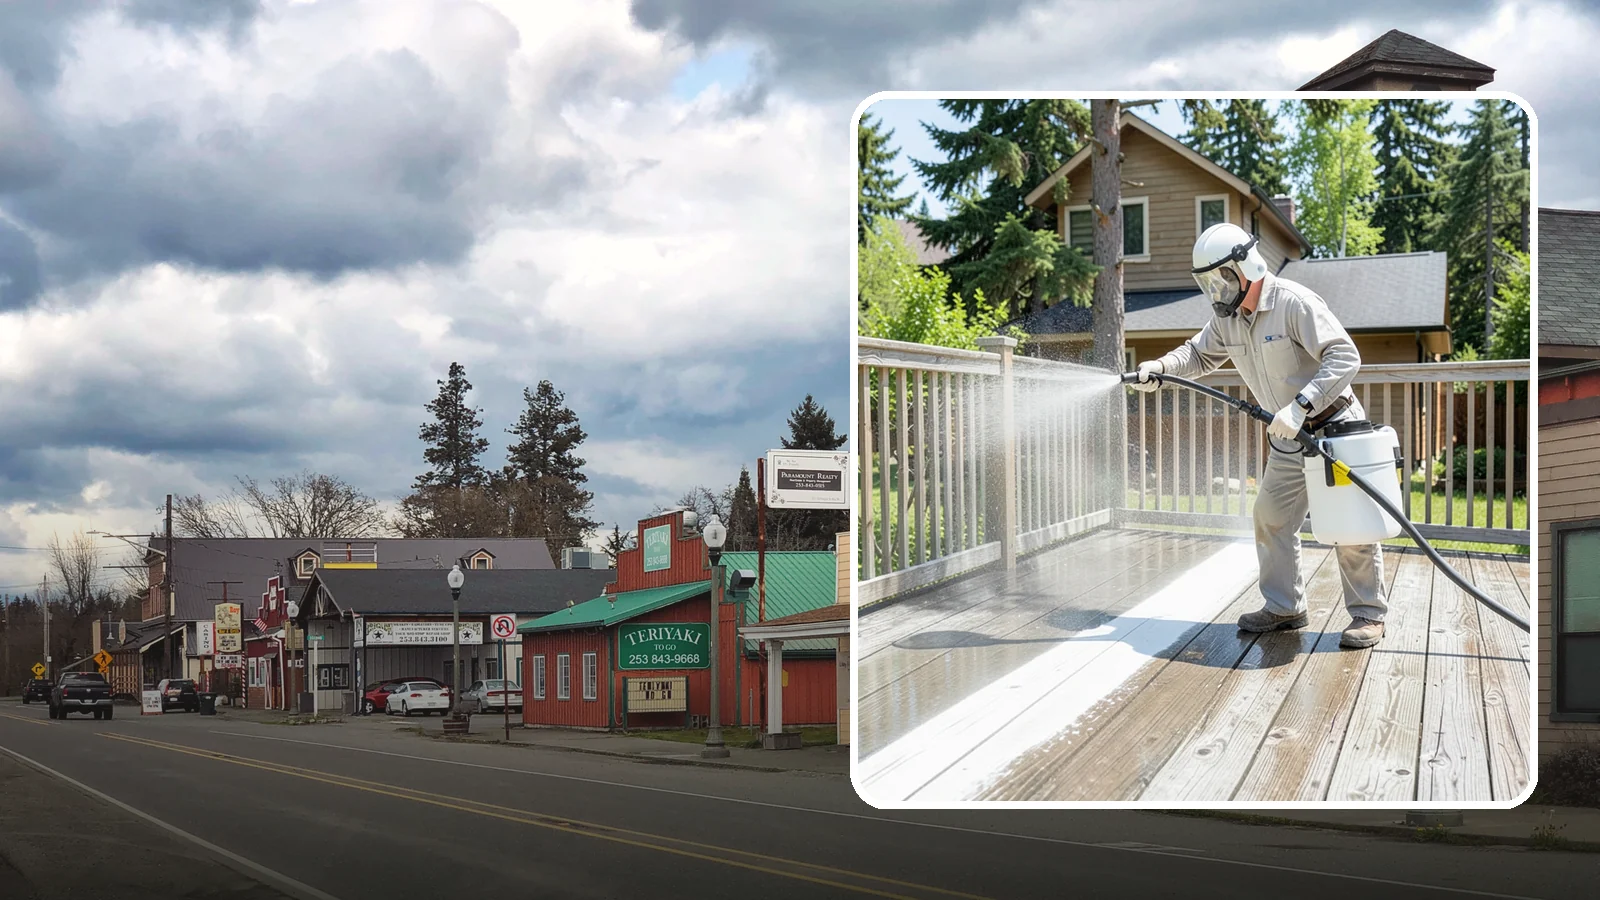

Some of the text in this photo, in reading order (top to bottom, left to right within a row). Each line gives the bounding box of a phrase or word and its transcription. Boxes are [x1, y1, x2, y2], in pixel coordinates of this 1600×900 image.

[781, 471, 838, 480] PARAMOUNT REALTY
[625, 627, 702, 646] TERIYAKI
[654, 643, 676, 651] TO GO
[628, 654, 700, 664] 253 843-9668
[639, 681, 672, 690] TERIYAKI
